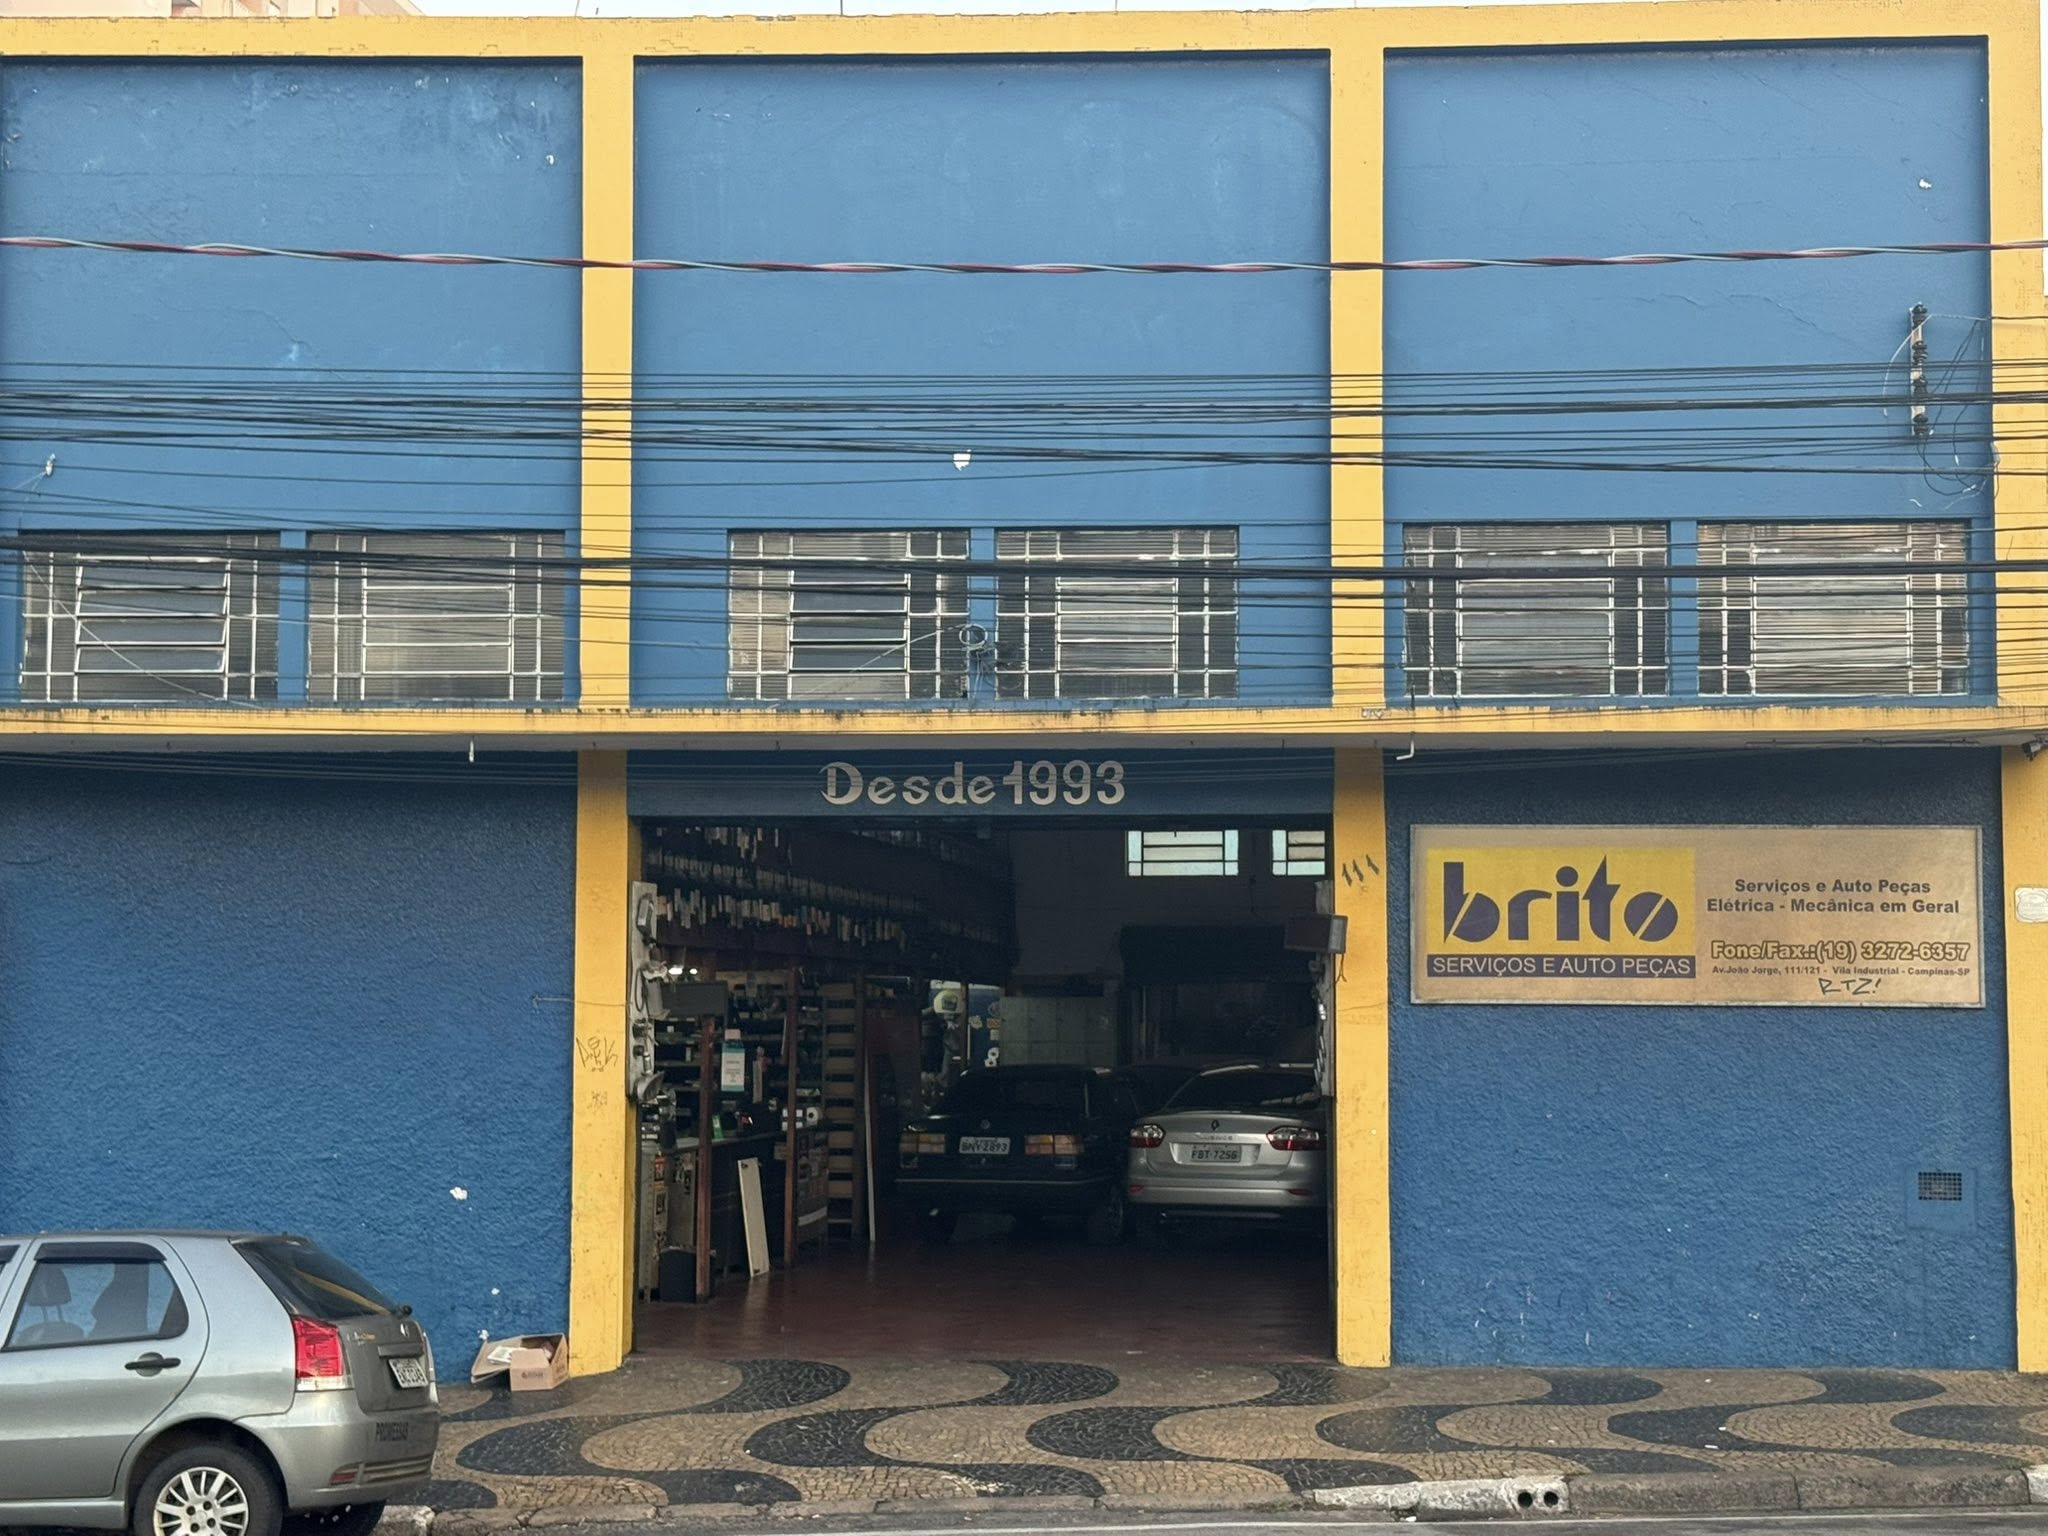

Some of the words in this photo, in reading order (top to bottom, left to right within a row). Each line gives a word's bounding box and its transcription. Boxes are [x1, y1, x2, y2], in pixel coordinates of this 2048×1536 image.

[819, 761, 997, 806] Desde
[1003, 759, 1126, 806] 1993
[1735, 879, 1810, 896] Serviços
[1816, 882, 1826, 893] e
[1832, 880, 1873, 893] Auto
[1878, 880, 1931, 896] Peças
[1442, 854, 1679, 944] brito
[1707, 898, 1774, 912] Elétrica
[1791, 898, 1874, 913] Mecânica
[1880, 902, 1906, 913] em
[1912, 899, 1960, 914] Geral
[1861, 941, 1971, 962] 3272-6357
[1432, 956, 1536, 977] SERVIÇOS
[1542, 957, 1555, 974] E
[1560, 957, 1616, 975] AUTO
[1622, 958, 1692, 978] PEÇAS
[1752, 966, 1781, 976] Jorge,
[1785, 966, 1820, 975] 111/121
[1832, 966, 1851, 975] Vila
[1854, 966, 1899, 975] Industrial
[1908, 967, 1970, 977] Campinas-SP
